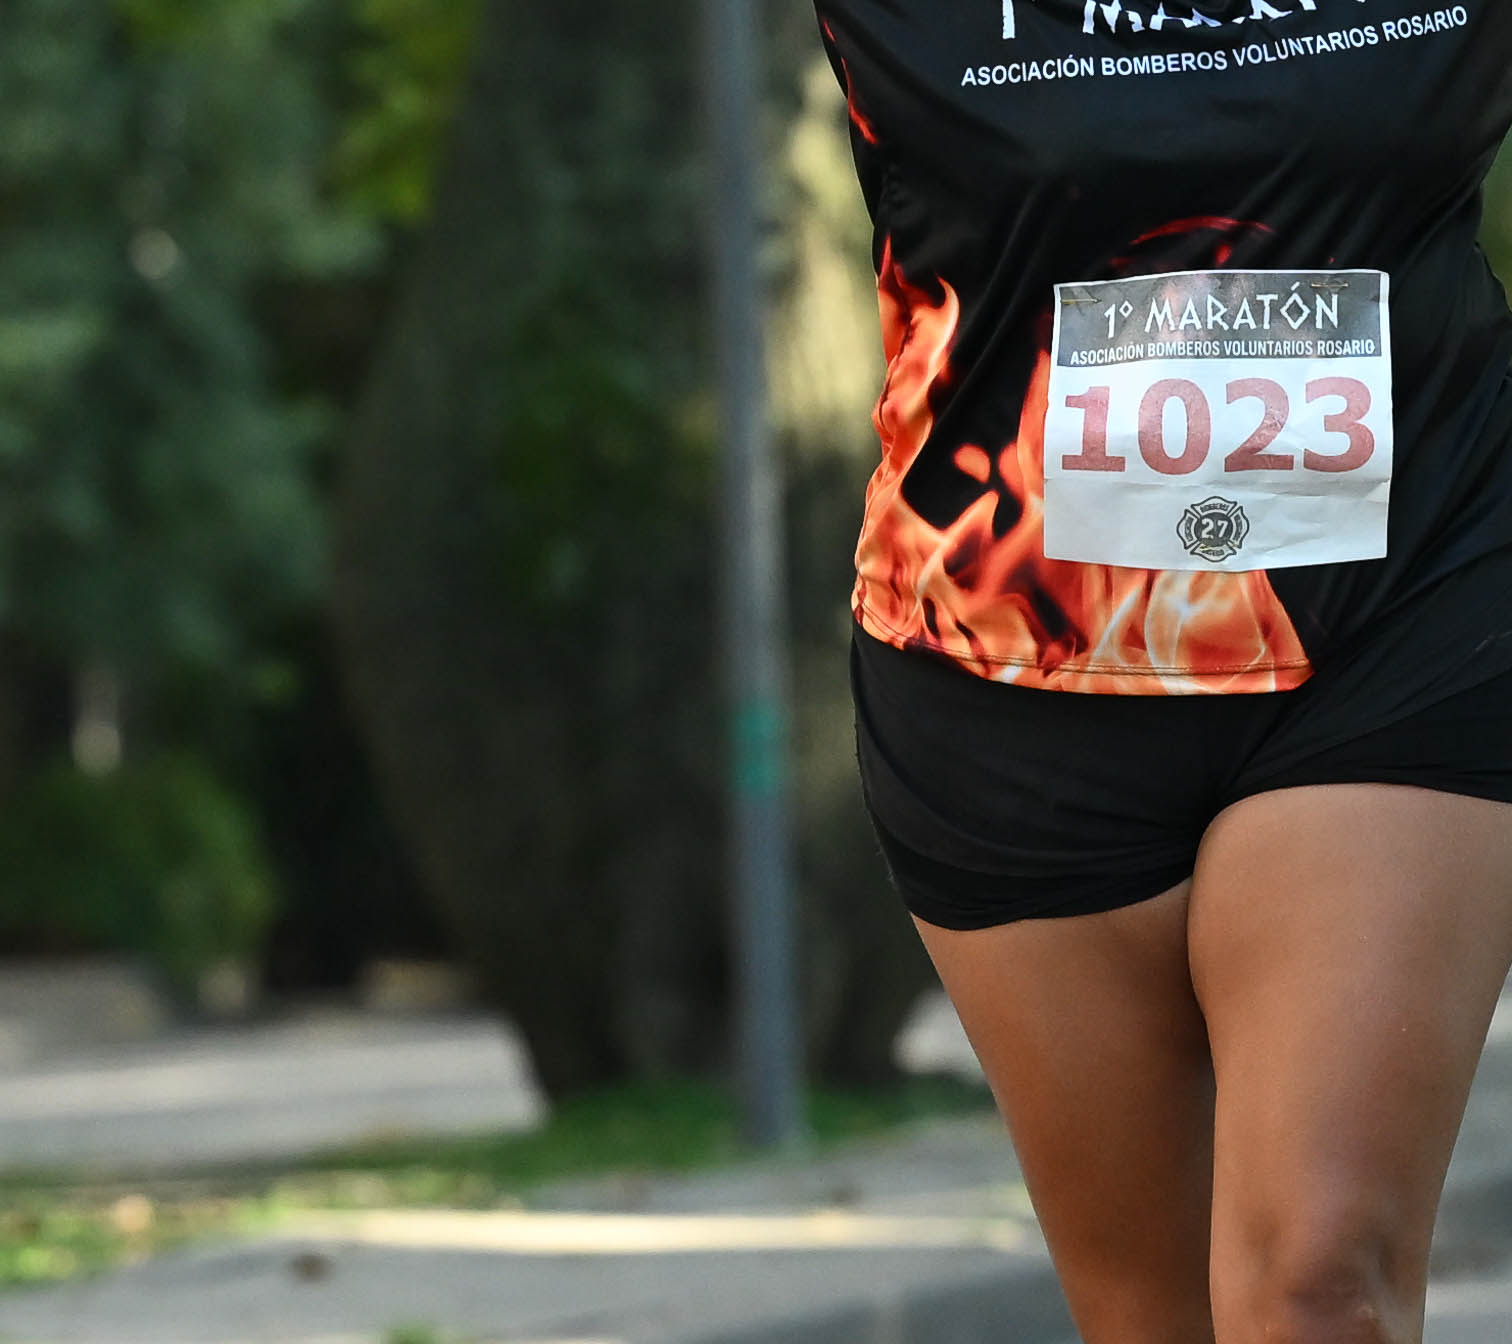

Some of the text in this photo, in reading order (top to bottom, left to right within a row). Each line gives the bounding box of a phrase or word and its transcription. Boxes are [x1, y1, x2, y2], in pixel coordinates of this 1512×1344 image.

[961, 5, 1468, 86] ASOCIACIÓN BOMBEROS VOLUNTARIOS ROSARIO
[1144, 281, 1339, 333] MARATÓN
[1070, 338, 1376, 365] ASOCIACIÓN BOMBEROS VOLUNTARIOS ROSARIO
[1061, 376, 1376, 476] 1023
[1201, 518, 1229, 540] 27
